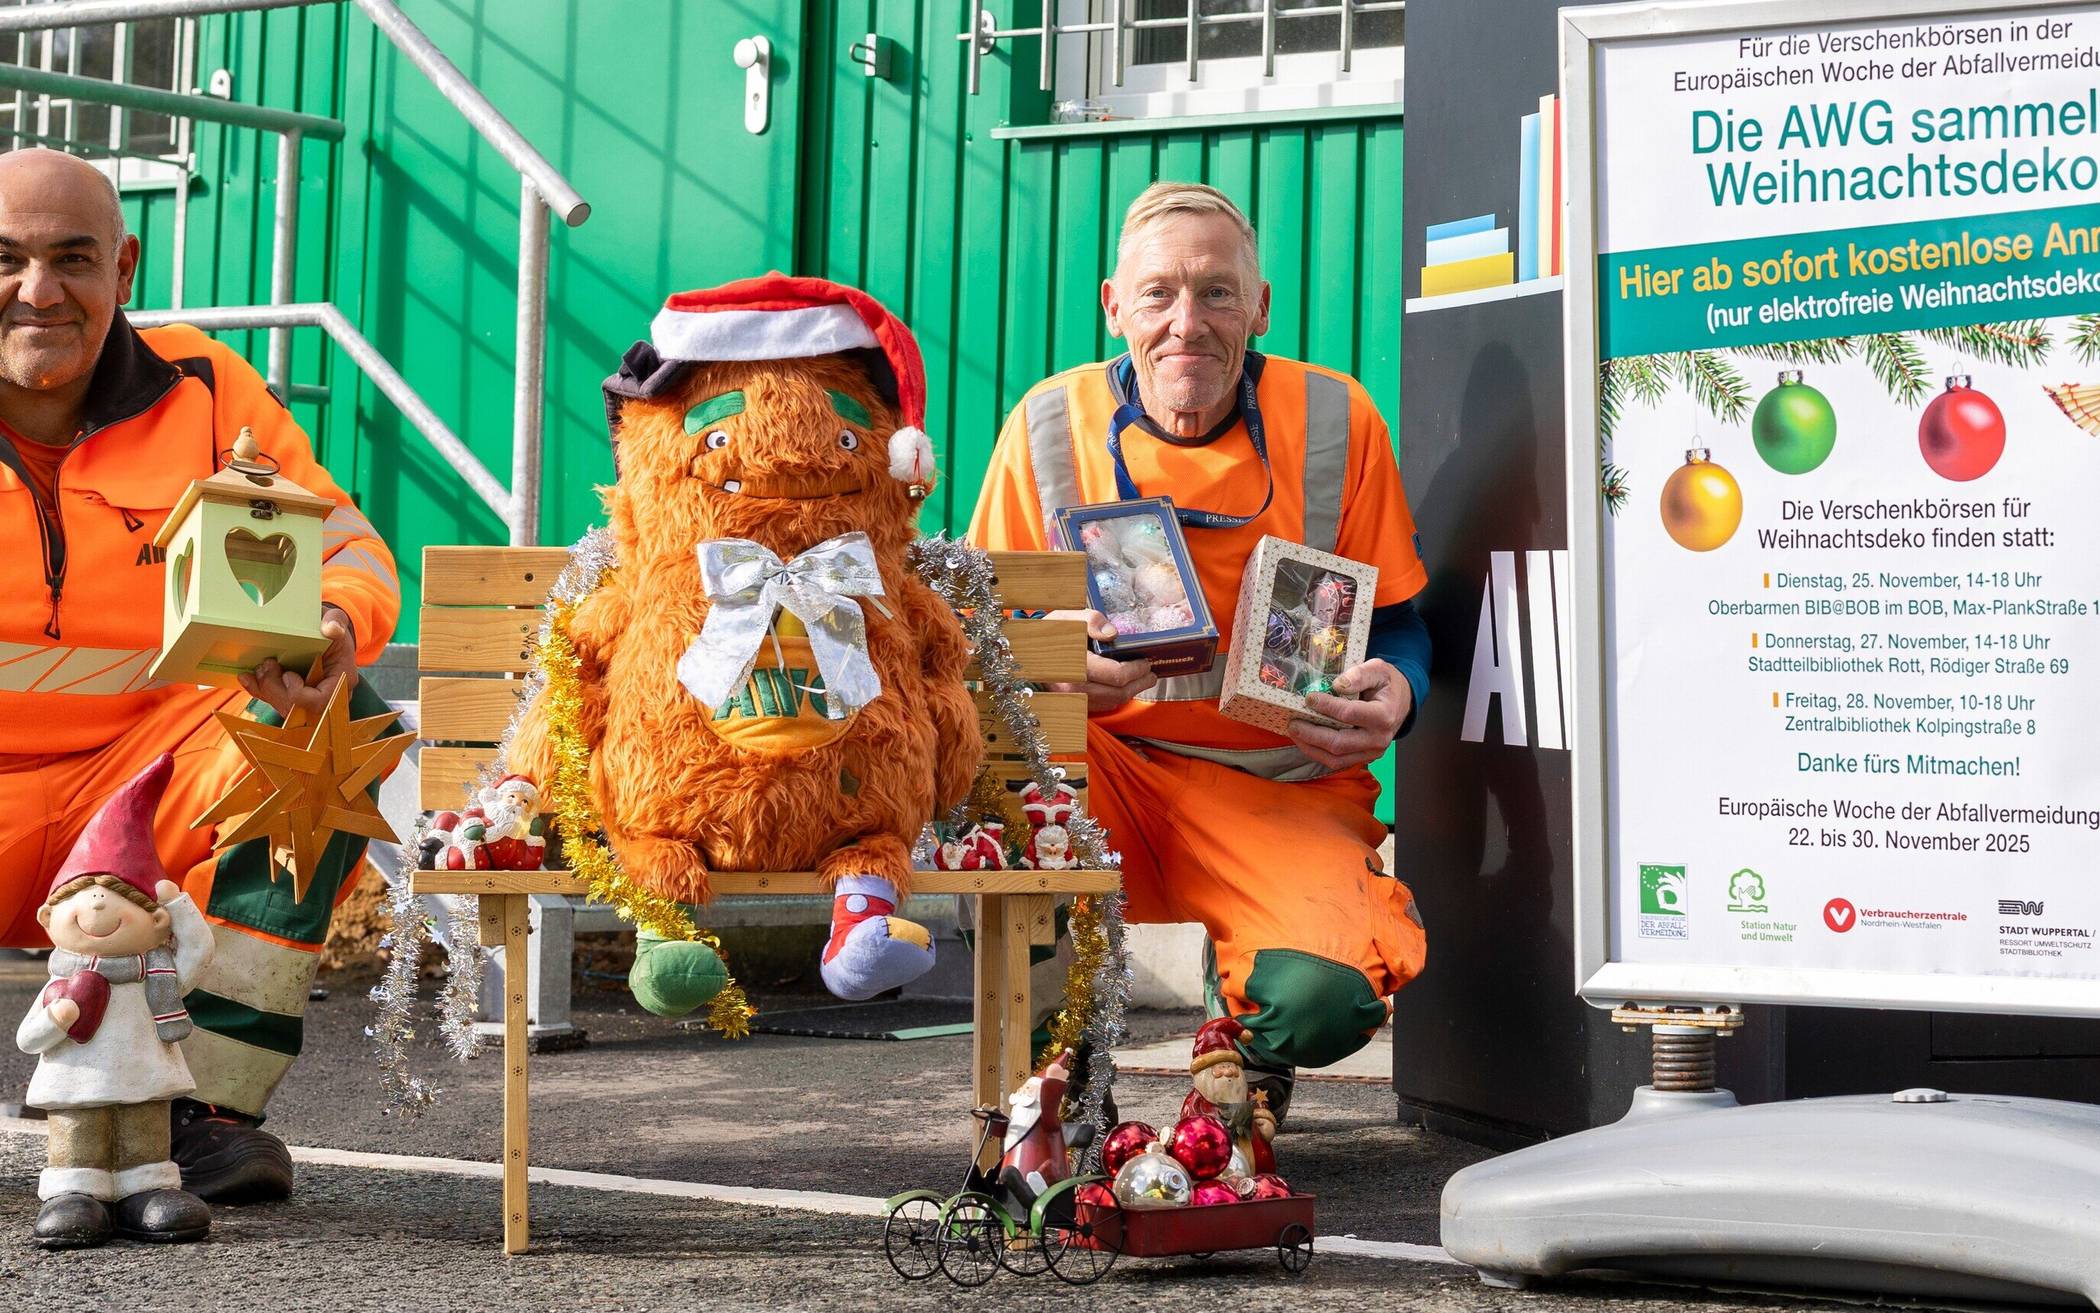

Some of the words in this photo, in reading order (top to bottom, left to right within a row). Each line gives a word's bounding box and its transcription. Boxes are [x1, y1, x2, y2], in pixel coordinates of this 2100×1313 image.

[1738, 37, 1774, 59] Für
[1778, 34, 1812, 56] die
[1816, 26, 2003, 54] Verschenkbörsen
[2010, 21, 2028, 41] in
[2036, 18, 2073, 40] der
[1674, 65, 1814, 94] Europäischen
[1820, 59, 1895, 83] Woche
[1901, 56, 1937, 79] der
[1692, 108, 1763, 155] Die
[1777, 99, 1893, 150] AWG
[1705, 146, 2098, 207] Weihnachtsdeko
[1619, 263, 1684, 300] Hier
[1693, 257, 1733, 291] ab
[1742, 246, 1840, 285] sofort
[1849, 230, 2034, 277] kostenlose
[1706, 303, 1753, 335] (nur
[1758, 287, 1894, 324] elektrofreie
[1782, 500, 1814, 521] Die
[1819, 498, 1996, 521] Verschenkbörsen
[2002, 497, 2032, 518] für
[1757, 527, 1926, 550] Weihnachtsdeko
[1931, 526, 1996, 548] finden
[2002, 527, 2055, 548] statt:
[1777, 572, 1847, 593] Dienstag,
[1851, 572, 1874, 589] 25.
[1879, 572, 1961, 591] November,
[1966, 571, 2010, 588] 14-18
[2014, 571, 2043, 588] Uhr
[1708, 599, 1800, 616] Oberbarmen
[1805, 599, 1880, 616] BIB@BOB
[1884, 599, 1903, 616] im
[1908, 599, 1948, 618] BOB,
[1953, 598, 2088, 616] Max-PlankStraße
[1765, 632, 1856, 653] Donnerstag,
[1860, 633, 1883, 649] 27.
[1888, 633, 1969, 652] November,
[1974, 633, 2018, 650] 14-18
[2022, 633, 2051, 650] Uhr
[1748, 655, 1884, 673] Stadtteilbibliothek
[1888, 657, 1925, 676] Rott,
[1930, 657, 1991, 678] Rödiger
[1994, 657, 2046, 675] Straße
[2049, 658, 2069, 675] 69
[1785, 692, 1841, 713] Freitag,
[1846, 692, 1869, 709] 28.
[1873, 693, 1955, 713] November,
[1959, 694, 2003, 711] 10-18
[2007, 694, 2036, 711] Uhr
[1784, 715, 1912, 733] Zentralbibliothek
[1916, 717, 2022, 738] Kolpingstraße
[2026, 718, 2036, 736] 8
[1798, 751, 1858, 773] Danke
[1863, 753, 1901, 774] fürs
[1907, 754, 2020, 777] Mitmachen!
[1718, 796, 1828, 821] Europäische
[1833, 799, 1896, 820] Woche
[1901, 801, 1932, 821] der
[1936, 802, 2100, 831] Abfallvermeidung
[1788, 827, 1815, 847] 22.
[1821, 827, 1847, 848] bis
[1852, 829, 1879, 849] 30.
[1885, 829, 1981, 852] November
[1985, 833, 2030, 854] 2025
[1740, 920, 1771, 931] Station
[1773, 922, 1798, 931] Natur
[1859, 908, 1968, 922] Verbraucherzentrale
[1860, 919, 1943, 930] Nordrhein-Westfalen
[1741, 932, 1759, 941] und
[1759, 933, 1793, 942] Umwelt
[1999, 925, 2029, 935] STADT
[2031, 927, 2091, 938] WUPPERTAL
[1999, 938, 2033, 947] RESSORT
[2033, 940, 2092, 950] UMWELTSCHUTZ
[1999, 947, 2063, 957] STADTBIBLIOTHEK
